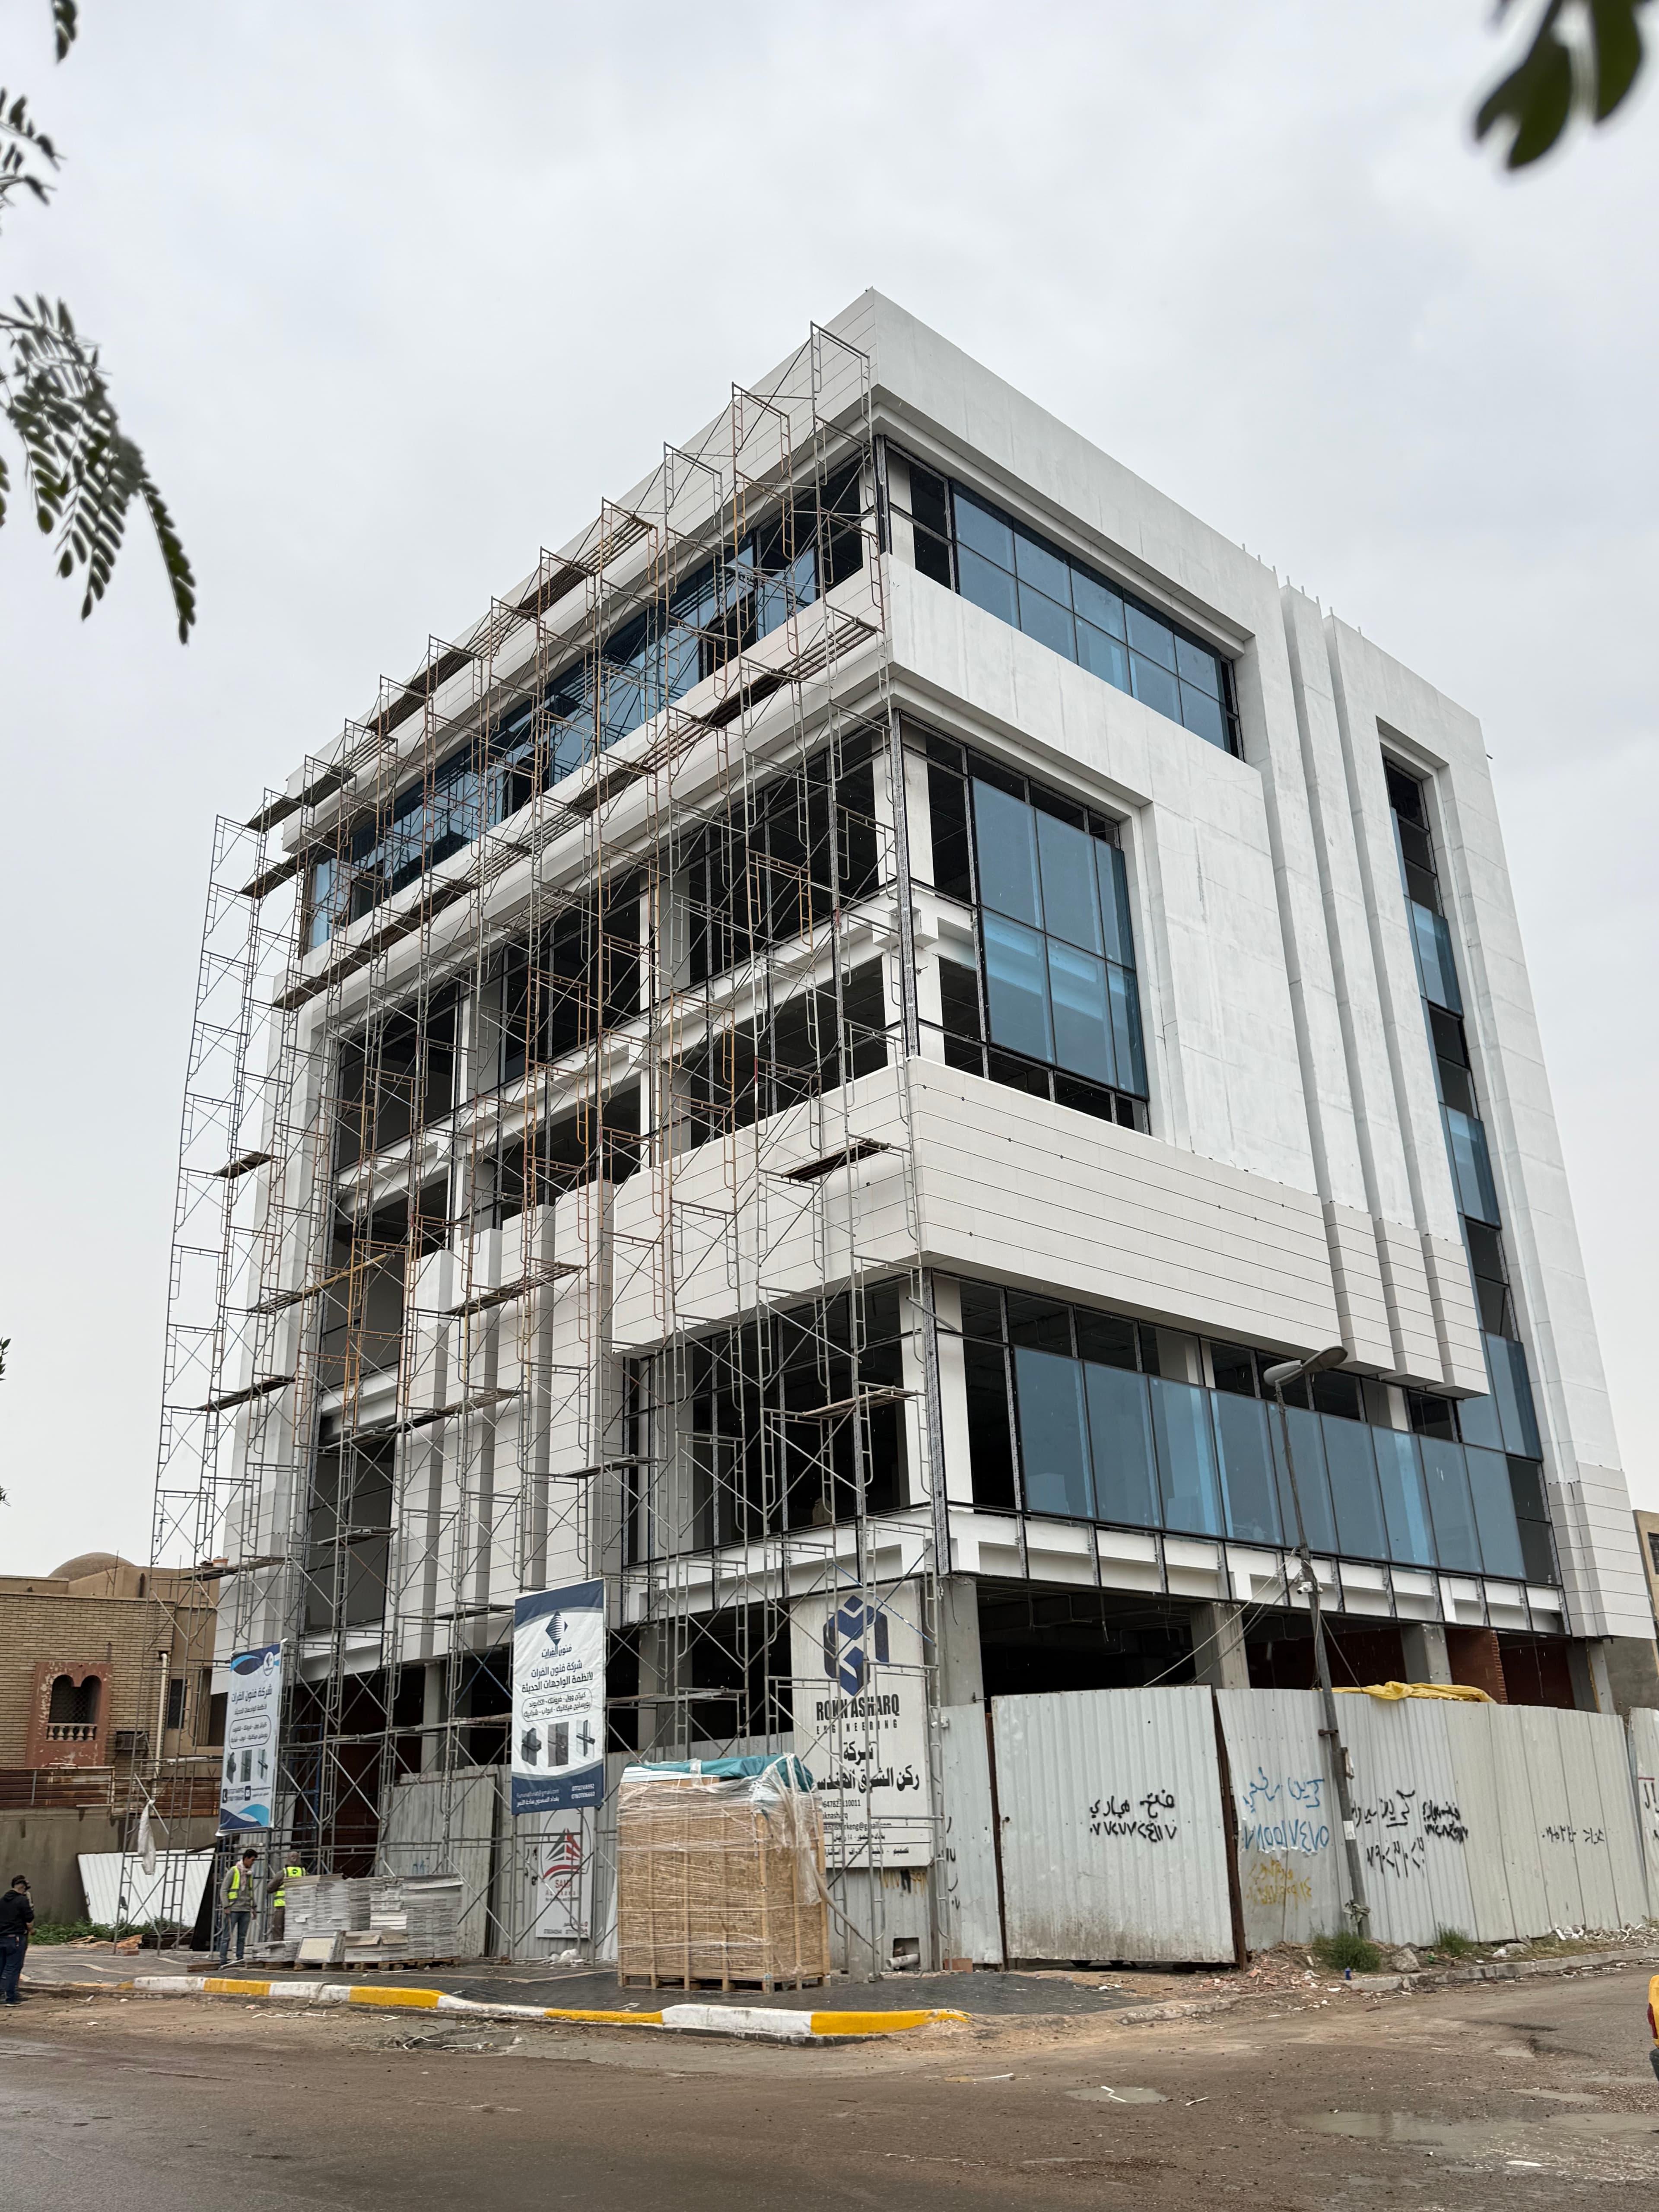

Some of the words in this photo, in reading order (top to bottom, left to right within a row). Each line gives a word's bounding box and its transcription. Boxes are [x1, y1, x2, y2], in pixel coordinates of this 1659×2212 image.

[550, 1664, 565, 1676] فنون
[567, 1659, 582, 1672] شركة
[531, 1666, 549, 1679] الفرات
[522, 1681, 542, 1694] الحديثة
[543, 1676, 570, 1689] الواجهات
[258, 1683, 273, 1699] شركة
[851, 1694, 899, 1718] ASHARQ
[817, 1719, 897, 1735] ENGNEERING
[896, 1764, 920, 1791] ركن
